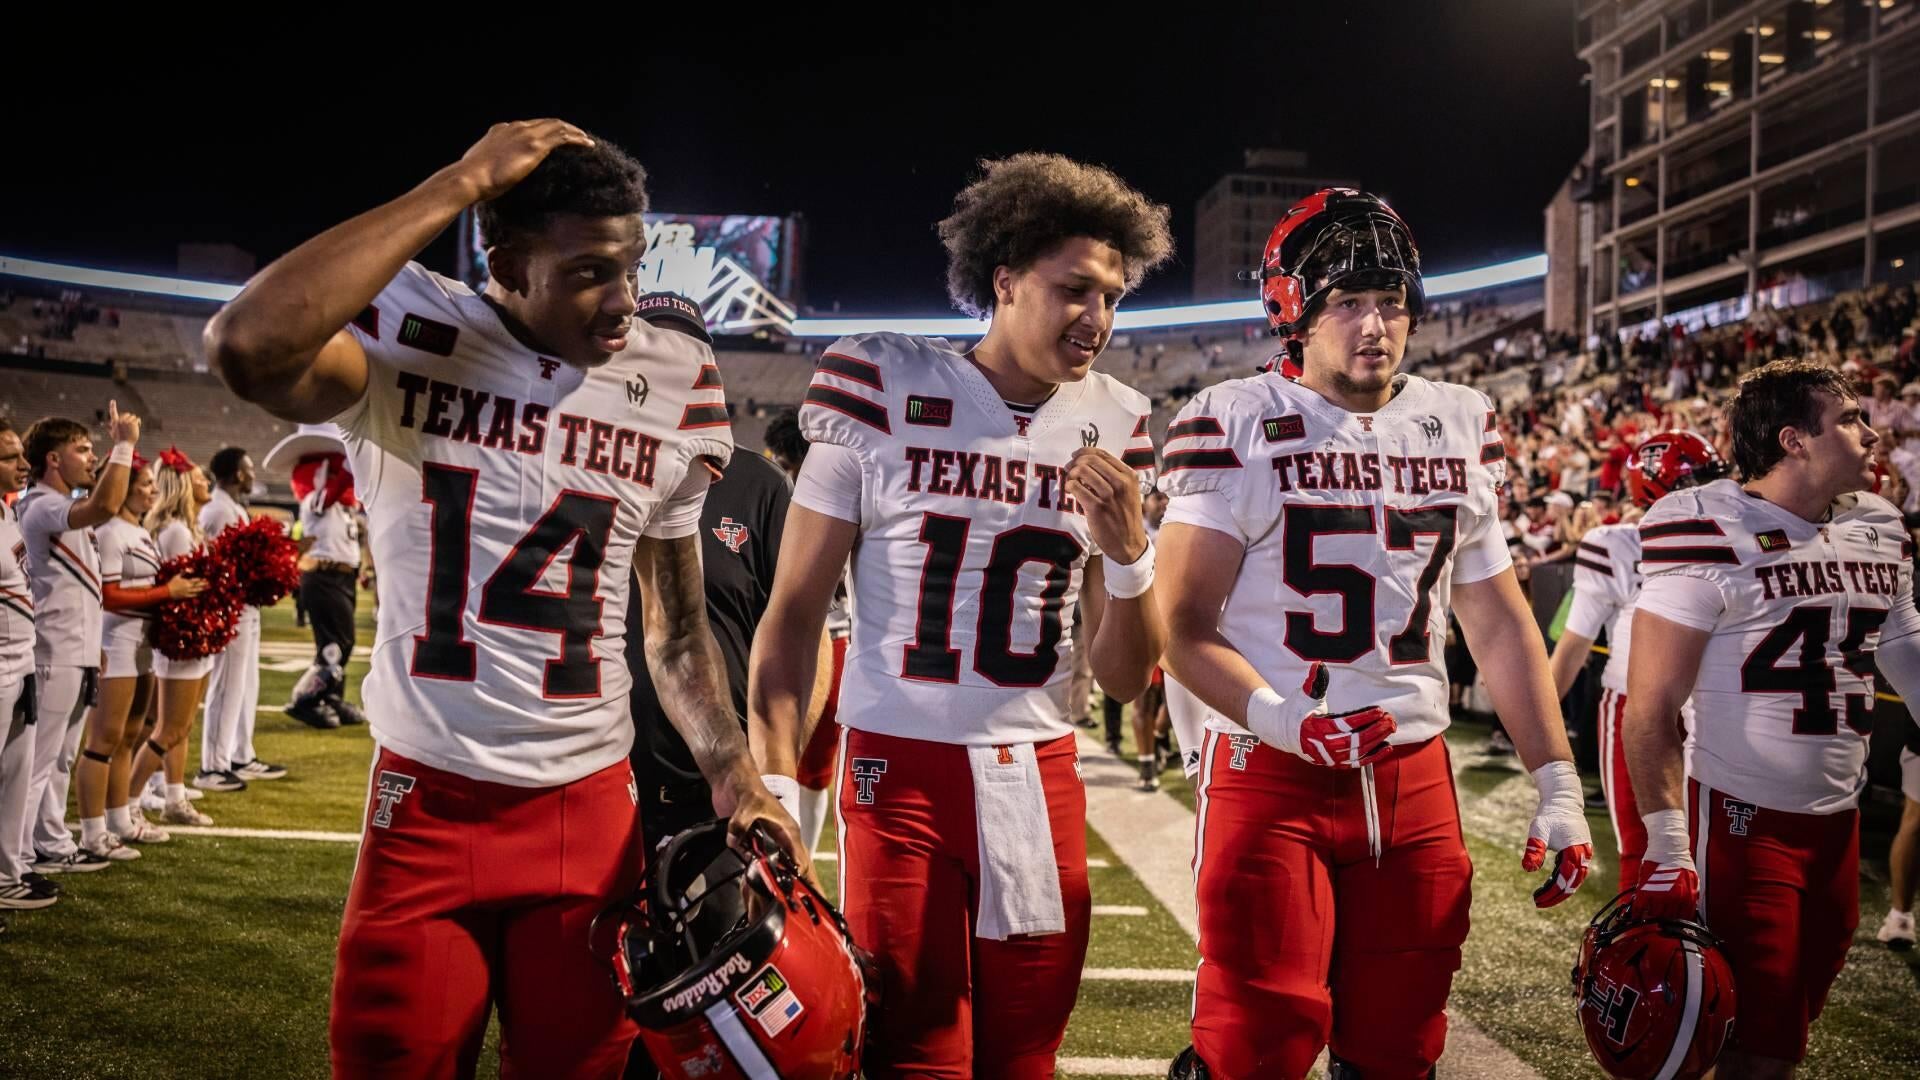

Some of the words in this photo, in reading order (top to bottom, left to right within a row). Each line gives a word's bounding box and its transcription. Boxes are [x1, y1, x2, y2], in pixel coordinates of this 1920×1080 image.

[636, 297, 670, 312] TEXAS
[671, 298, 696, 317] TECH
[397, 372, 549, 455] TEXAS
[559, 412, 662, 488] TECH
[905, 446, 1027, 505] TEXAS
[1034, 463, 1085, 516] TE
[1272, 452, 1382, 492] TEXAS
[1386, 455, 1468, 495] TECH
[410, 461, 621, 698] 14
[900, 511, 1084, 688] 10
[1282, 503, 1458, 665] 57
[1755, 561, 1846, 600] TEXAS
[1740, 606, 1890, 735] 45
